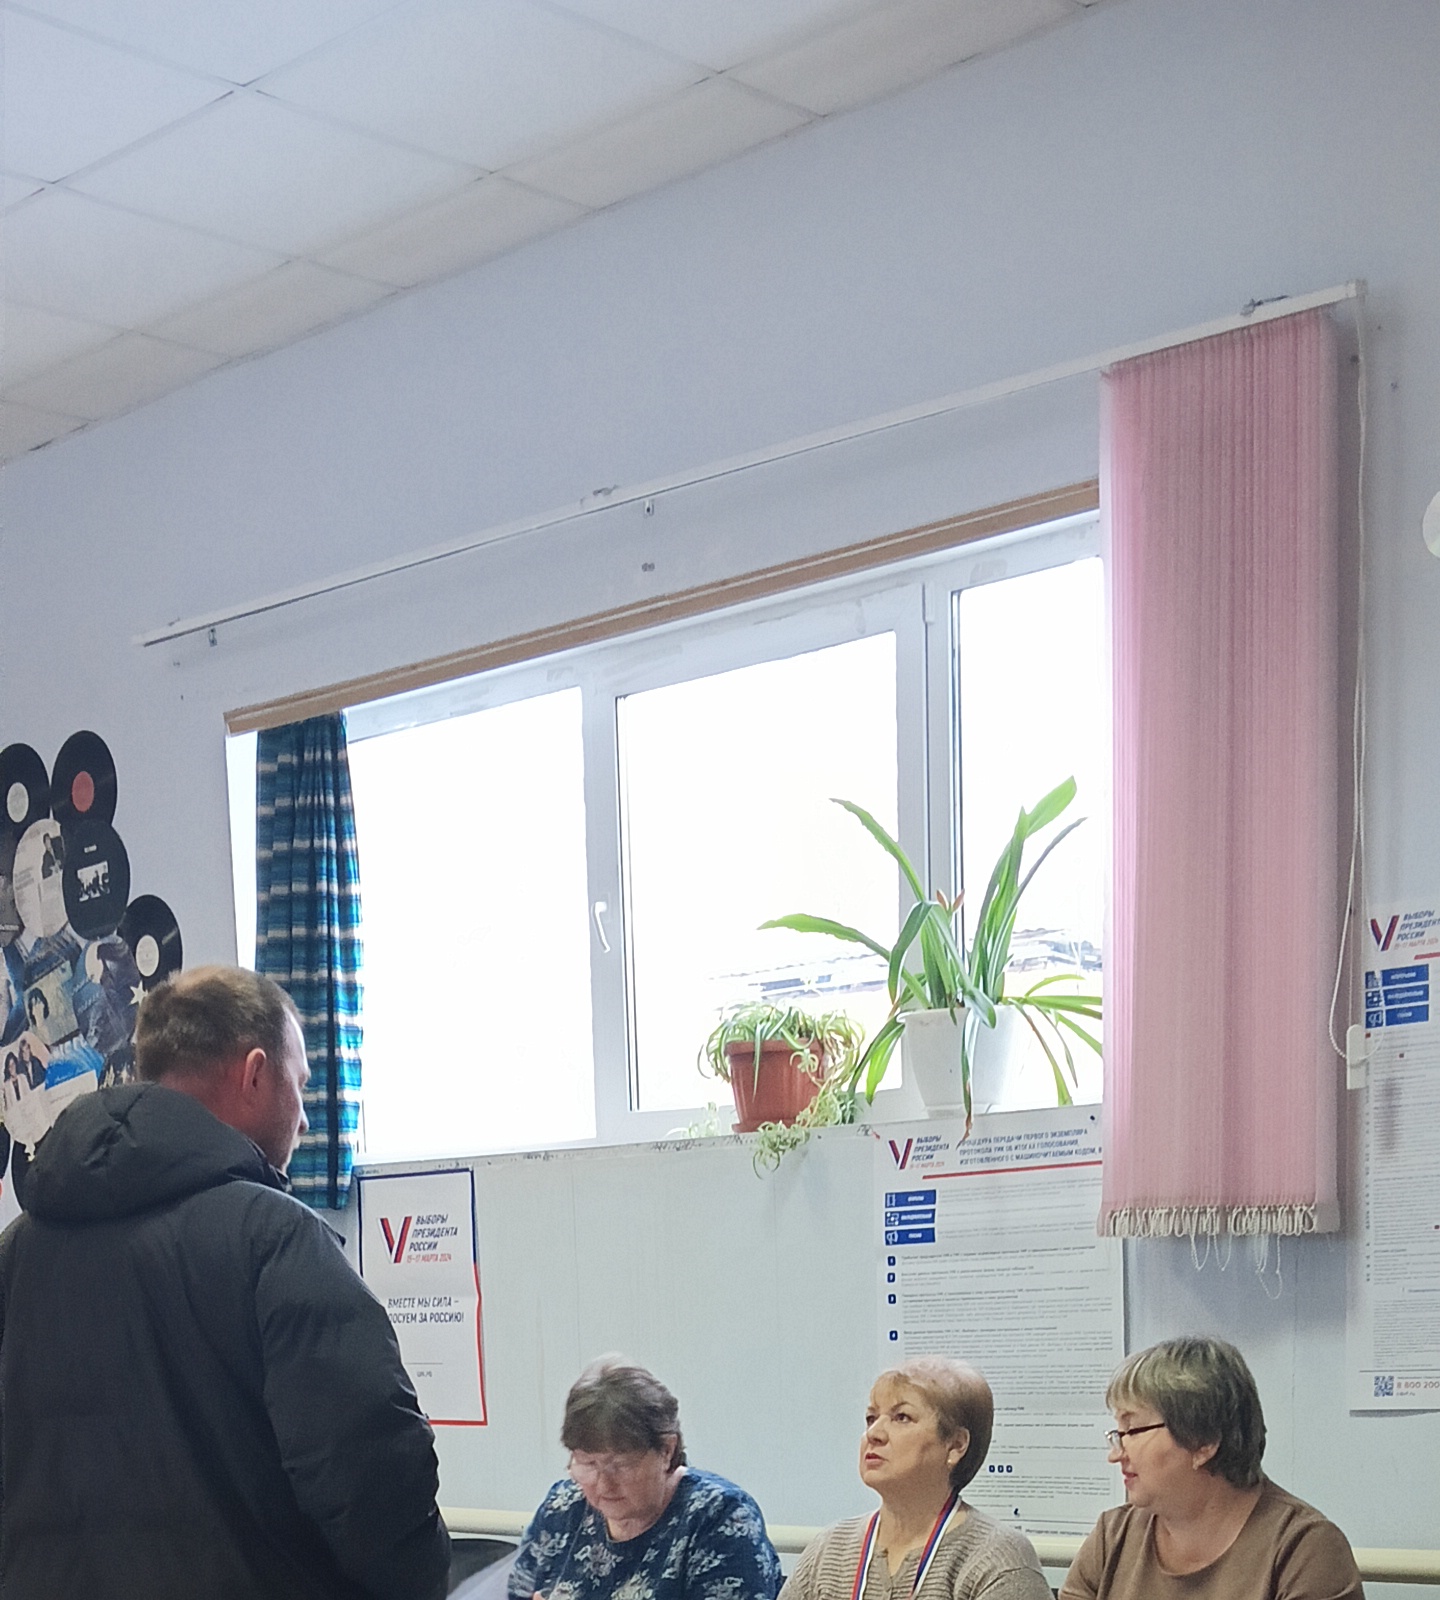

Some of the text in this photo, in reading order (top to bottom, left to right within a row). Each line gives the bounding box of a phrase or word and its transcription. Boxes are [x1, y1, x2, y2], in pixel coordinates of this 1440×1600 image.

[1403, 910, 1435, 921] ВЫБОРЫ
[1400, 918, 1440, 930] ПРЕЗИДЕНТ
[1396, 930, 1426, 941] РОССИИ
[916, 1135, 942, 1144] ВЫБОРЫ
[960, 1128, 1088, 1147] РОЦЕДУРА ПЕРЕДАЧИ ПЕРВОГО ЭКЗЕМПЛЯРА
[914, 1143, 950, 1153] ПРЕЗИДЕНТА
[959, 1147, 992, 1156] ПРОТОКОЛА
[911, 1153, 934, 1162] РОССИИ
[960, 1155, 1009, 1166] ИЗГОТОВЛЕННОГО
[416, 1214, 449, 1225] ВЫБОРЫ
[412, 1227, 458, 1239] ПРЕЗИДЕНТА
[409, 1241, 438, 1252] РОССИИ
[387, 1297, 416, 1309] ВМЕСТЕ
[417, 1296, 431, 1308] МЫ
[432, 1296, 452, 1308] СИЛА
[389, 1311, 464, 1324] ЛОСУЕМ ЗА РОССИЮ!
